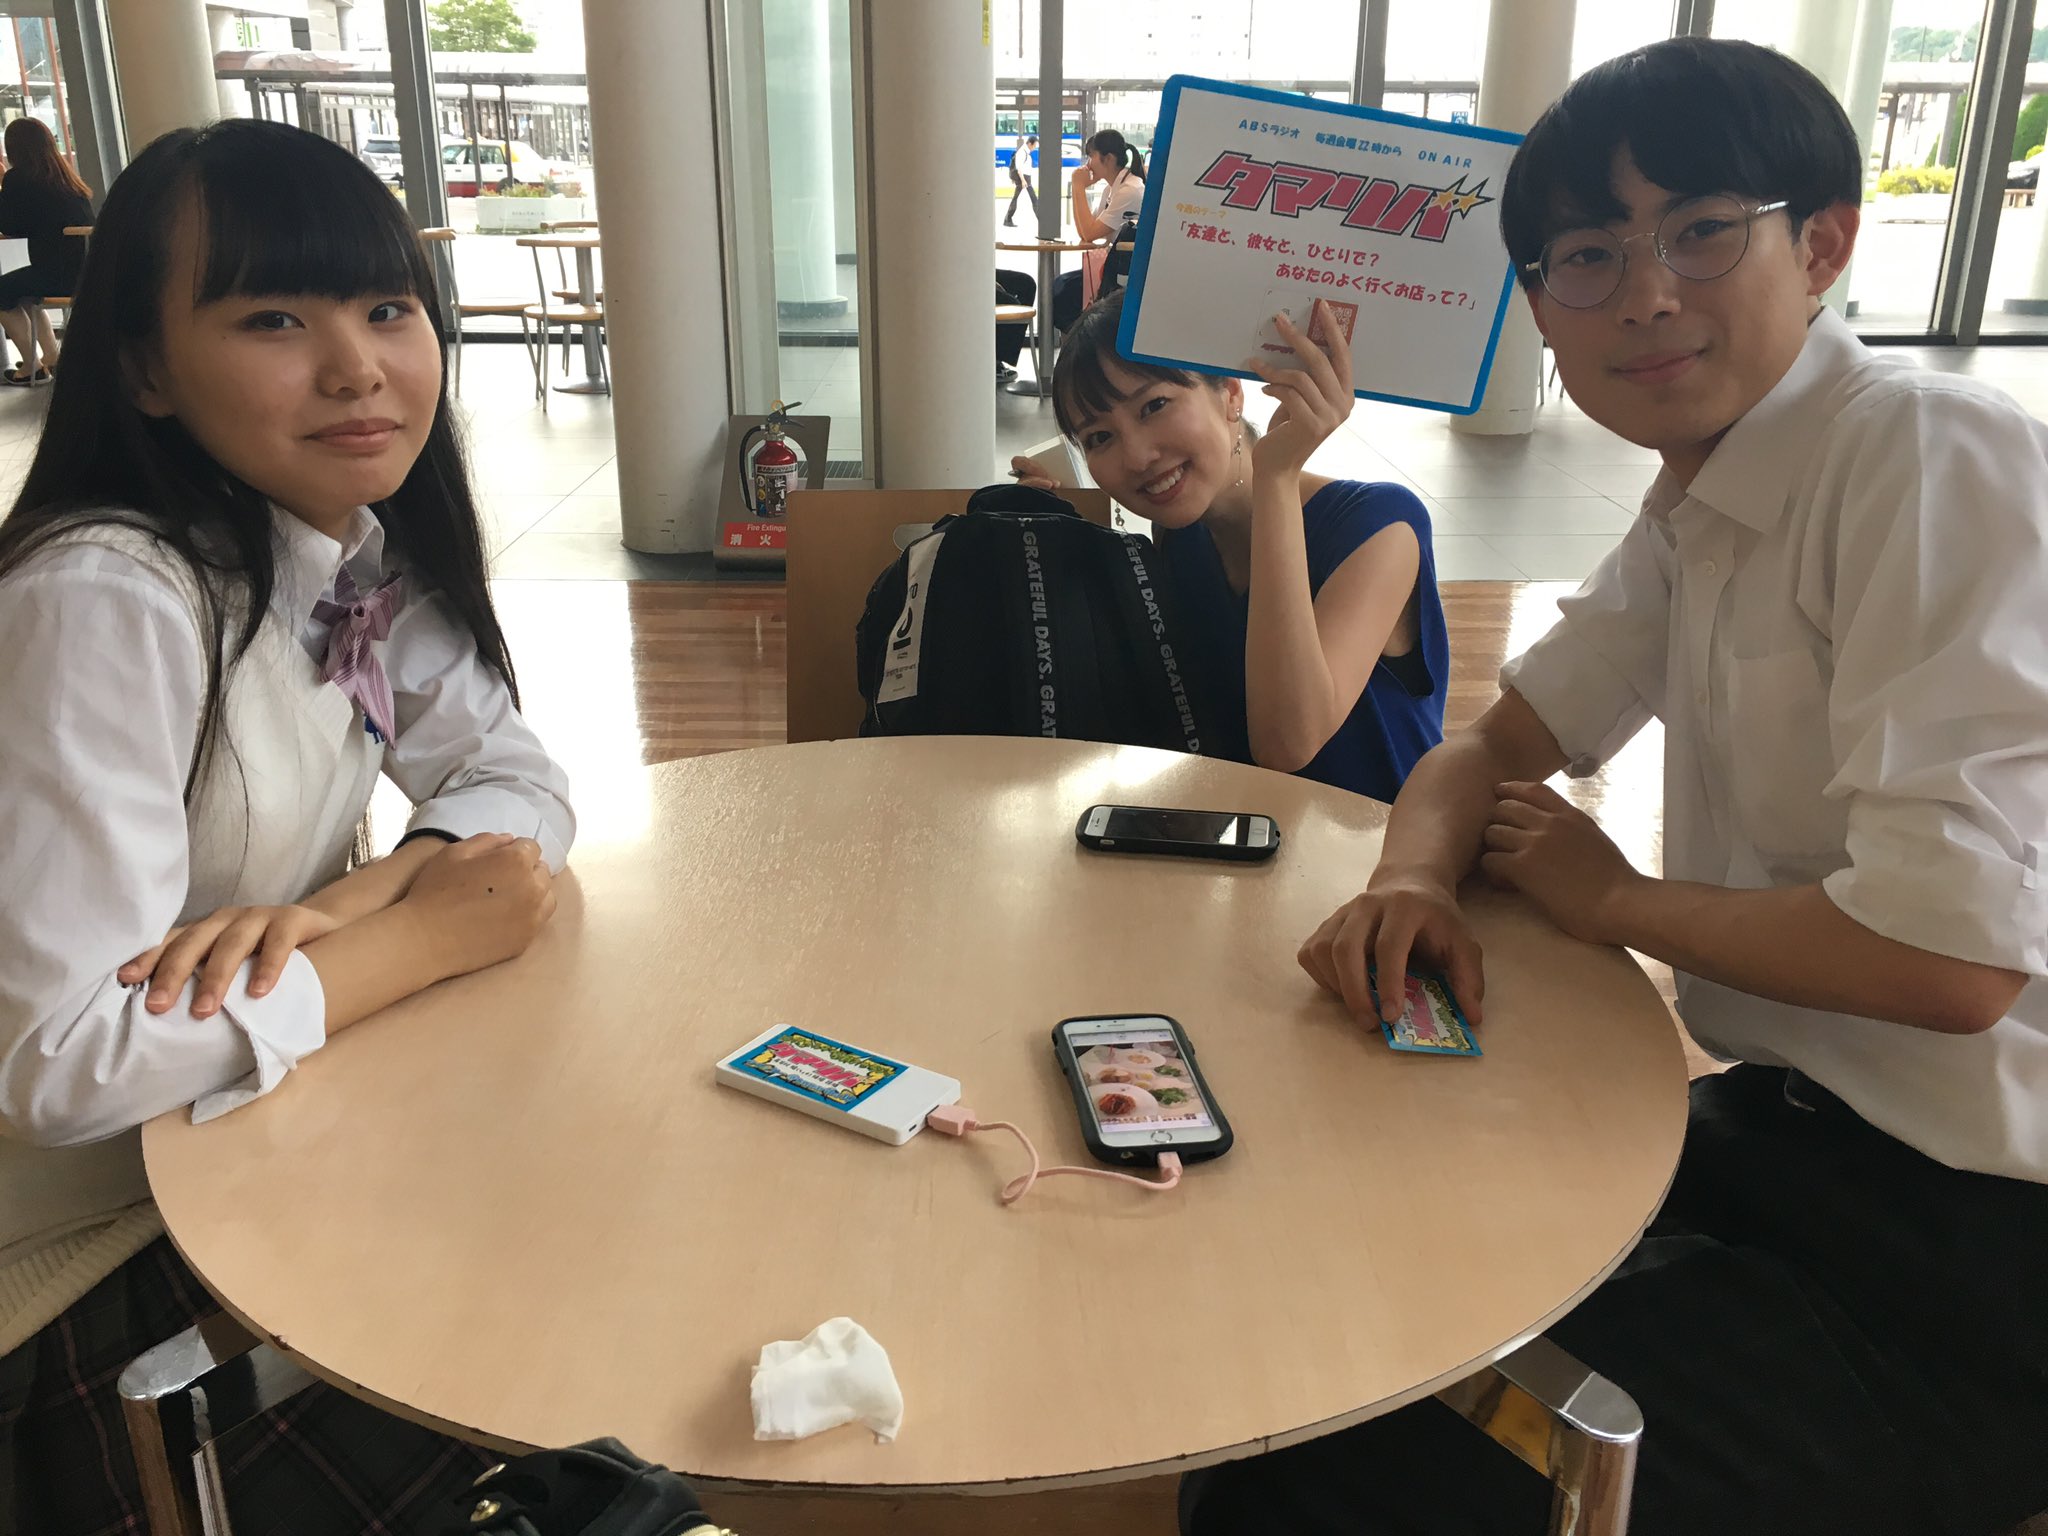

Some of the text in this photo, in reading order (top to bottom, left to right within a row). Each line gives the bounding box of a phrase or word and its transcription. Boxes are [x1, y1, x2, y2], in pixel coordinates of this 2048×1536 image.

[1239, 119, 1300, 139] ABSラジオ
[1418, 150, 1437, 162] ON
[1442, 154, 1472, 169] AIR
[747, 523, 760, 531] Fire
[1023, 531, 1048, 621] GRATEFUL
[1034, 626, 1053, 680] DAYS.
[1141, 588, 1165, 640] DAYS.
[1160, 644, 1196, 736] GRATEFUL
